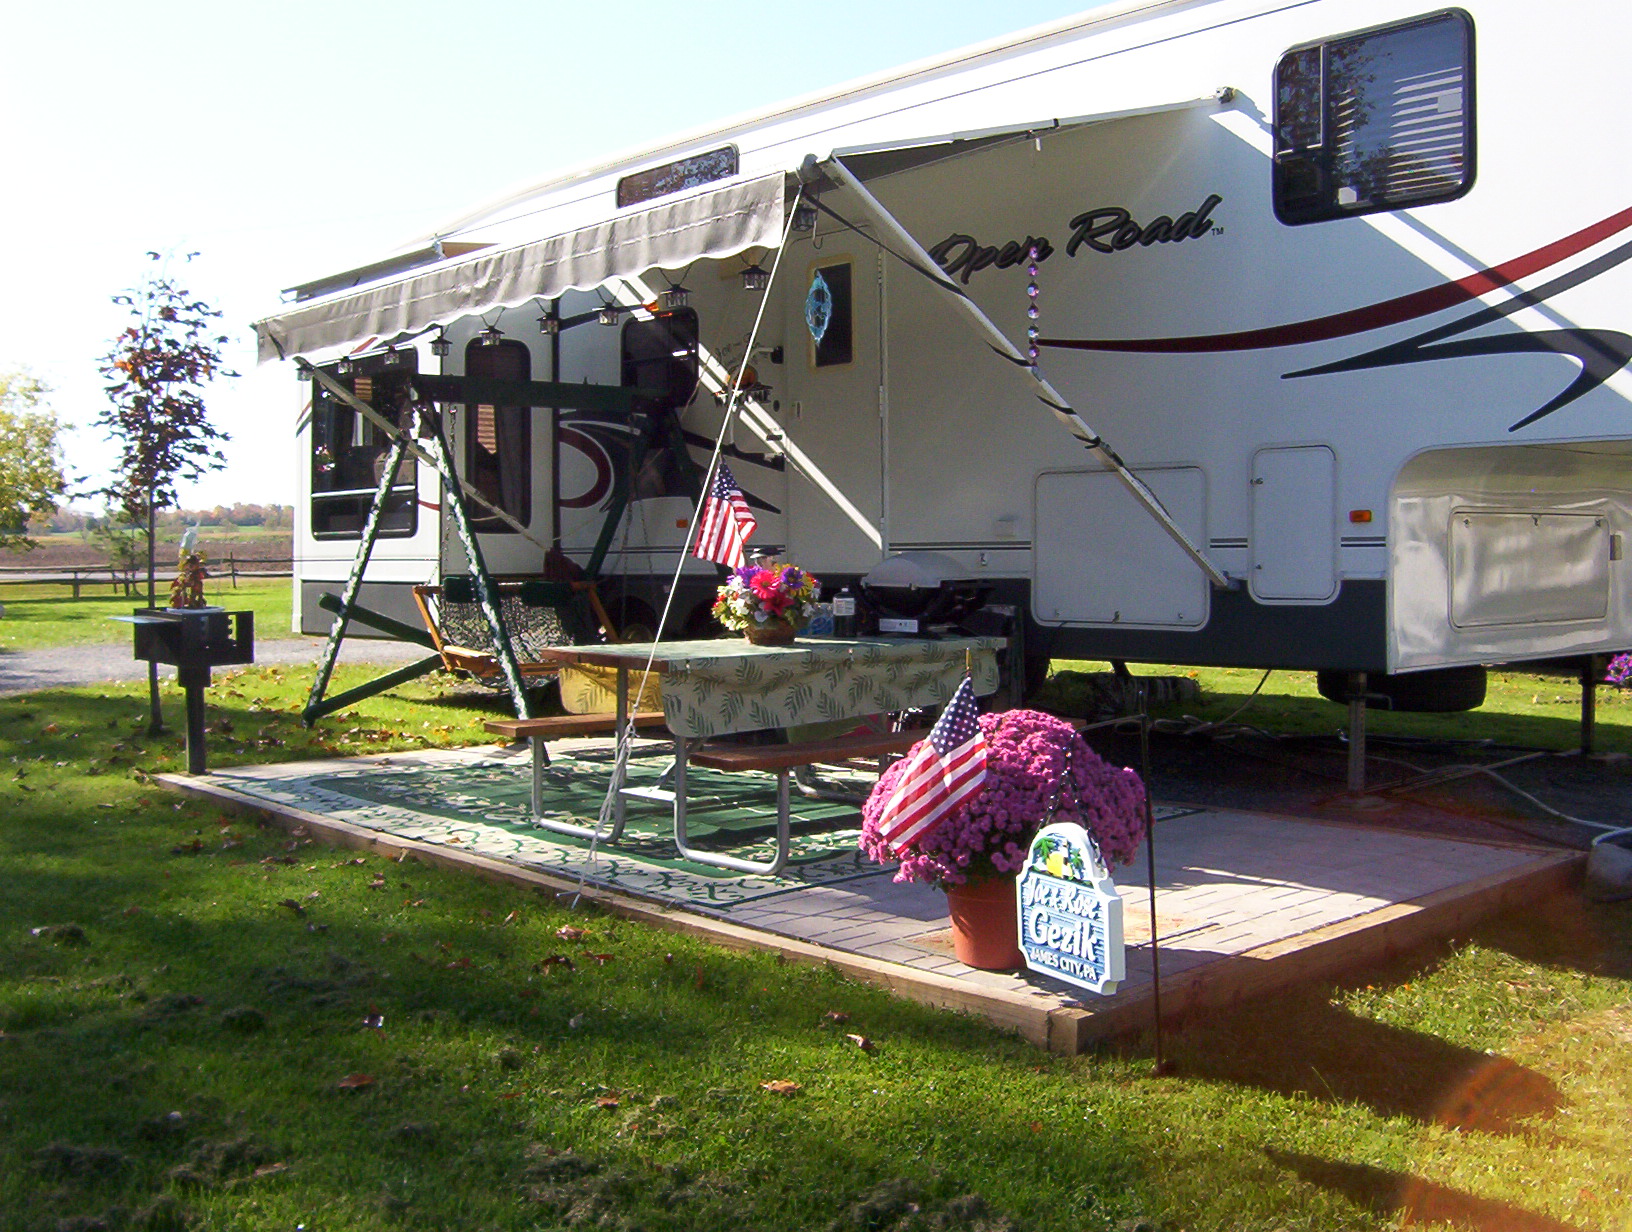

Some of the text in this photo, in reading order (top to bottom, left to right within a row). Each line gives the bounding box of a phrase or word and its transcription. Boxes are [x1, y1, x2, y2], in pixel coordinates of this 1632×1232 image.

[928, 232, 1054, 284] Open
[1066, 194, 1222, 257] Road
[1029, 906, 1097, 961] Gezik
[1030, 947, 1059, 968] JAMES
